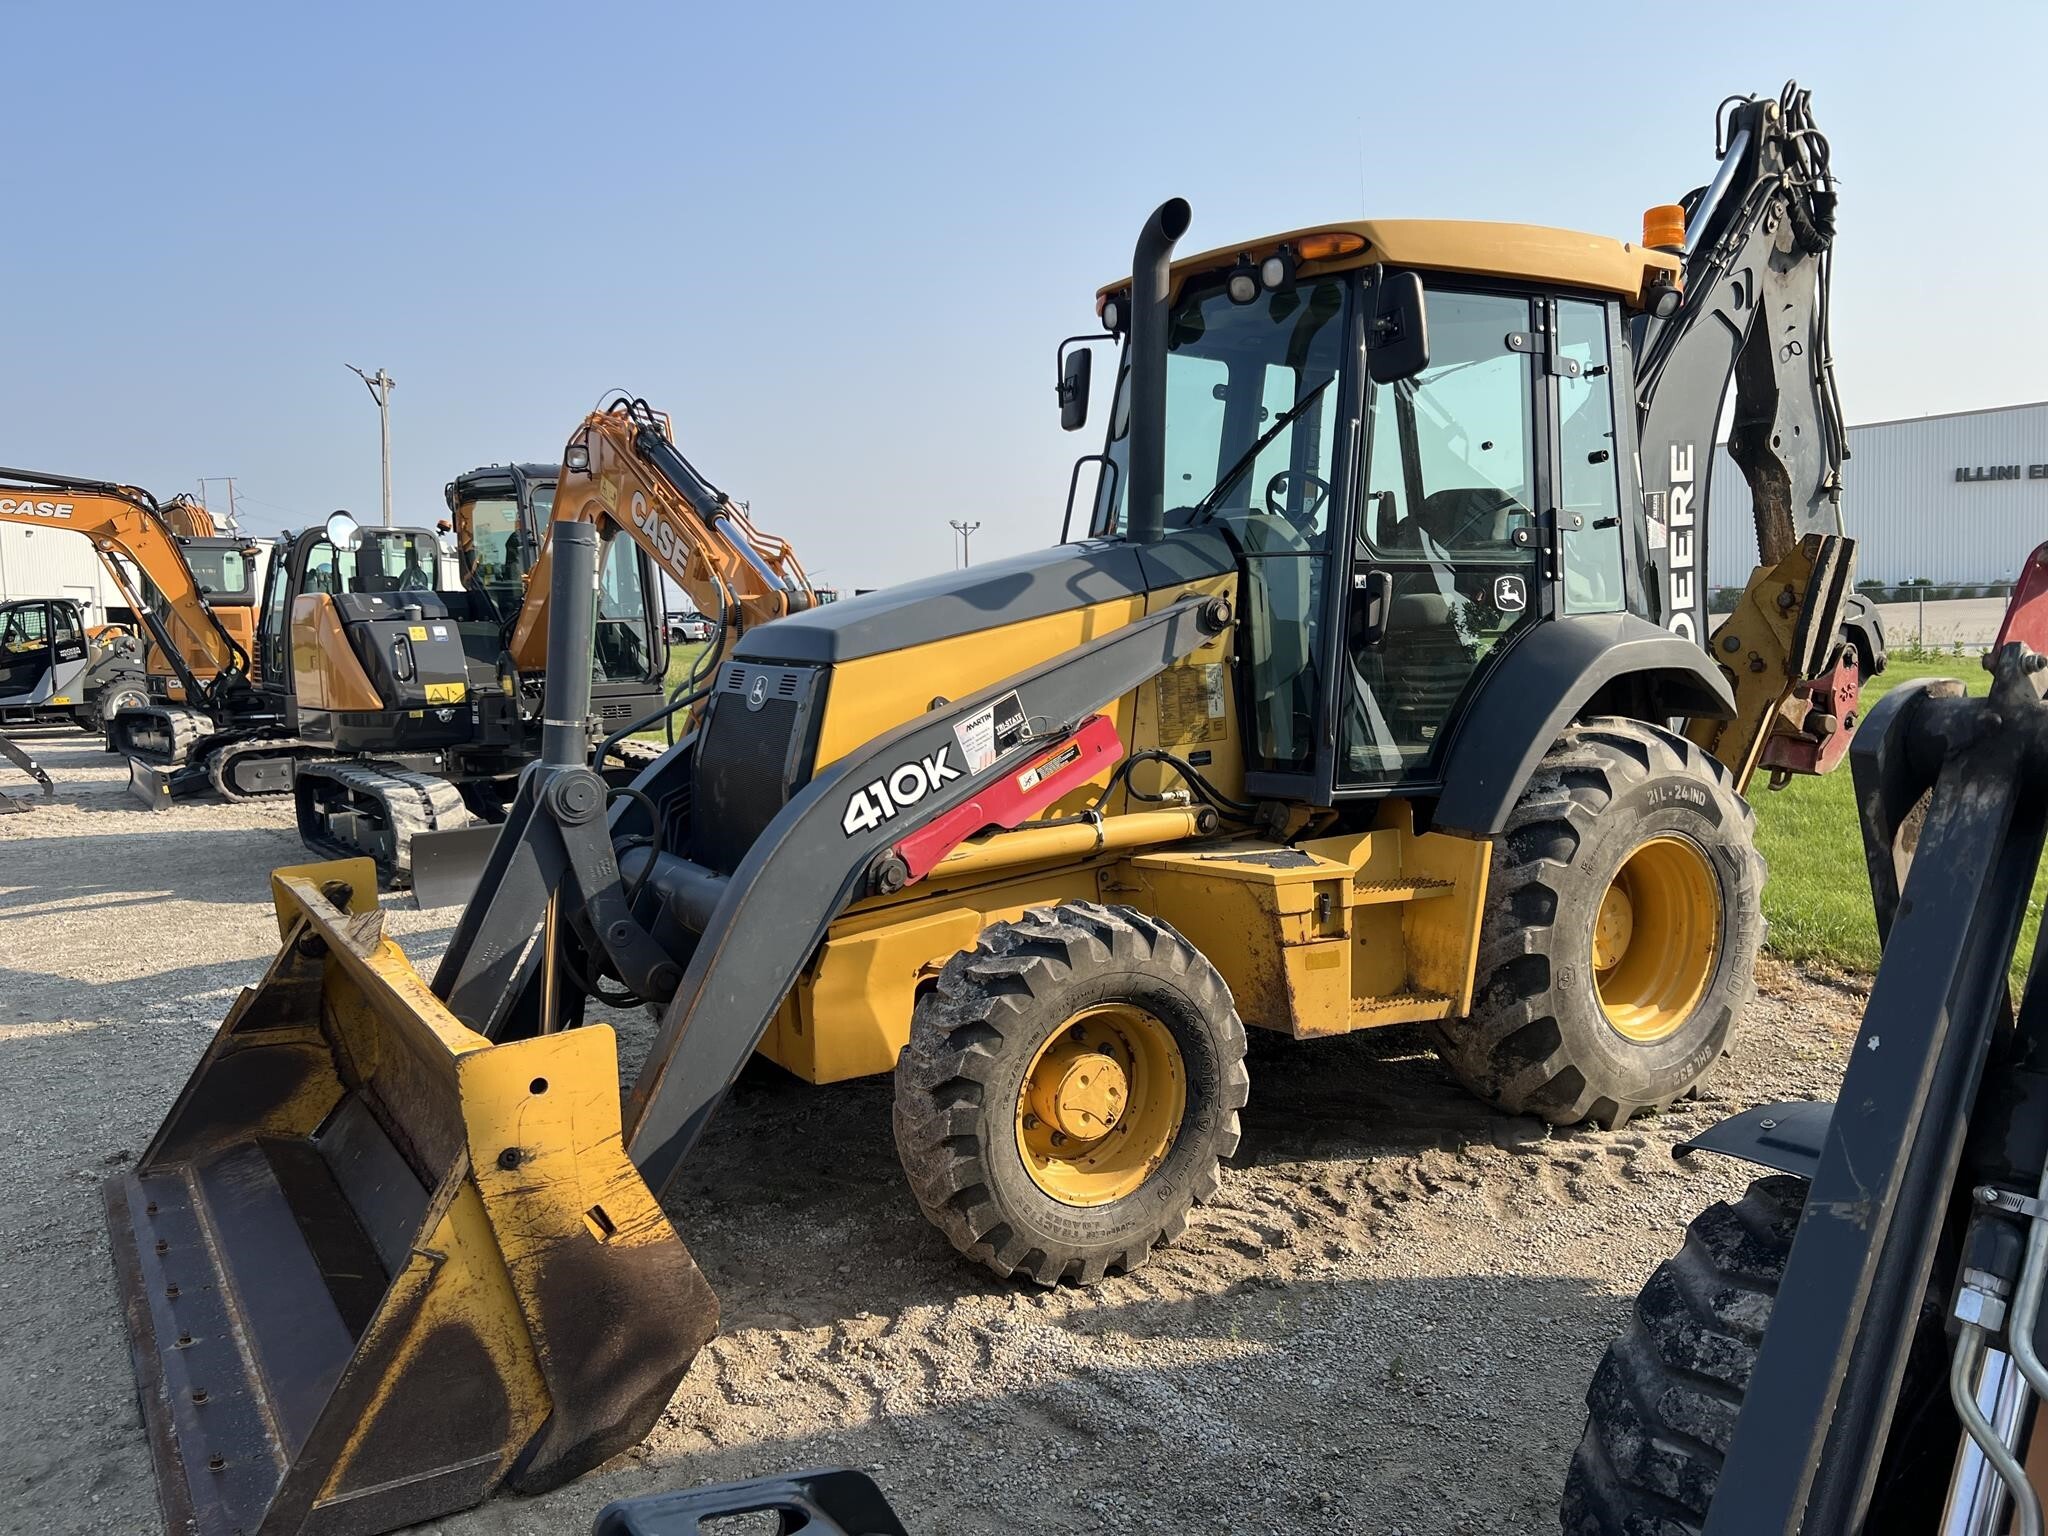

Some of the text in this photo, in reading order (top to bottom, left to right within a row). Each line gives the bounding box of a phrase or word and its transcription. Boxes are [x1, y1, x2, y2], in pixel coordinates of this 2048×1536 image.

[1955, 465, 2021, 482] ILLINI
[0, 499, 74, 519] CASE
[631, 490, 691, 578] CASE
[1669, 443, 1696, 644] DEERE
[966, 712, 992, 733] MARTIN
[842, 743, 965, 837] 410K
